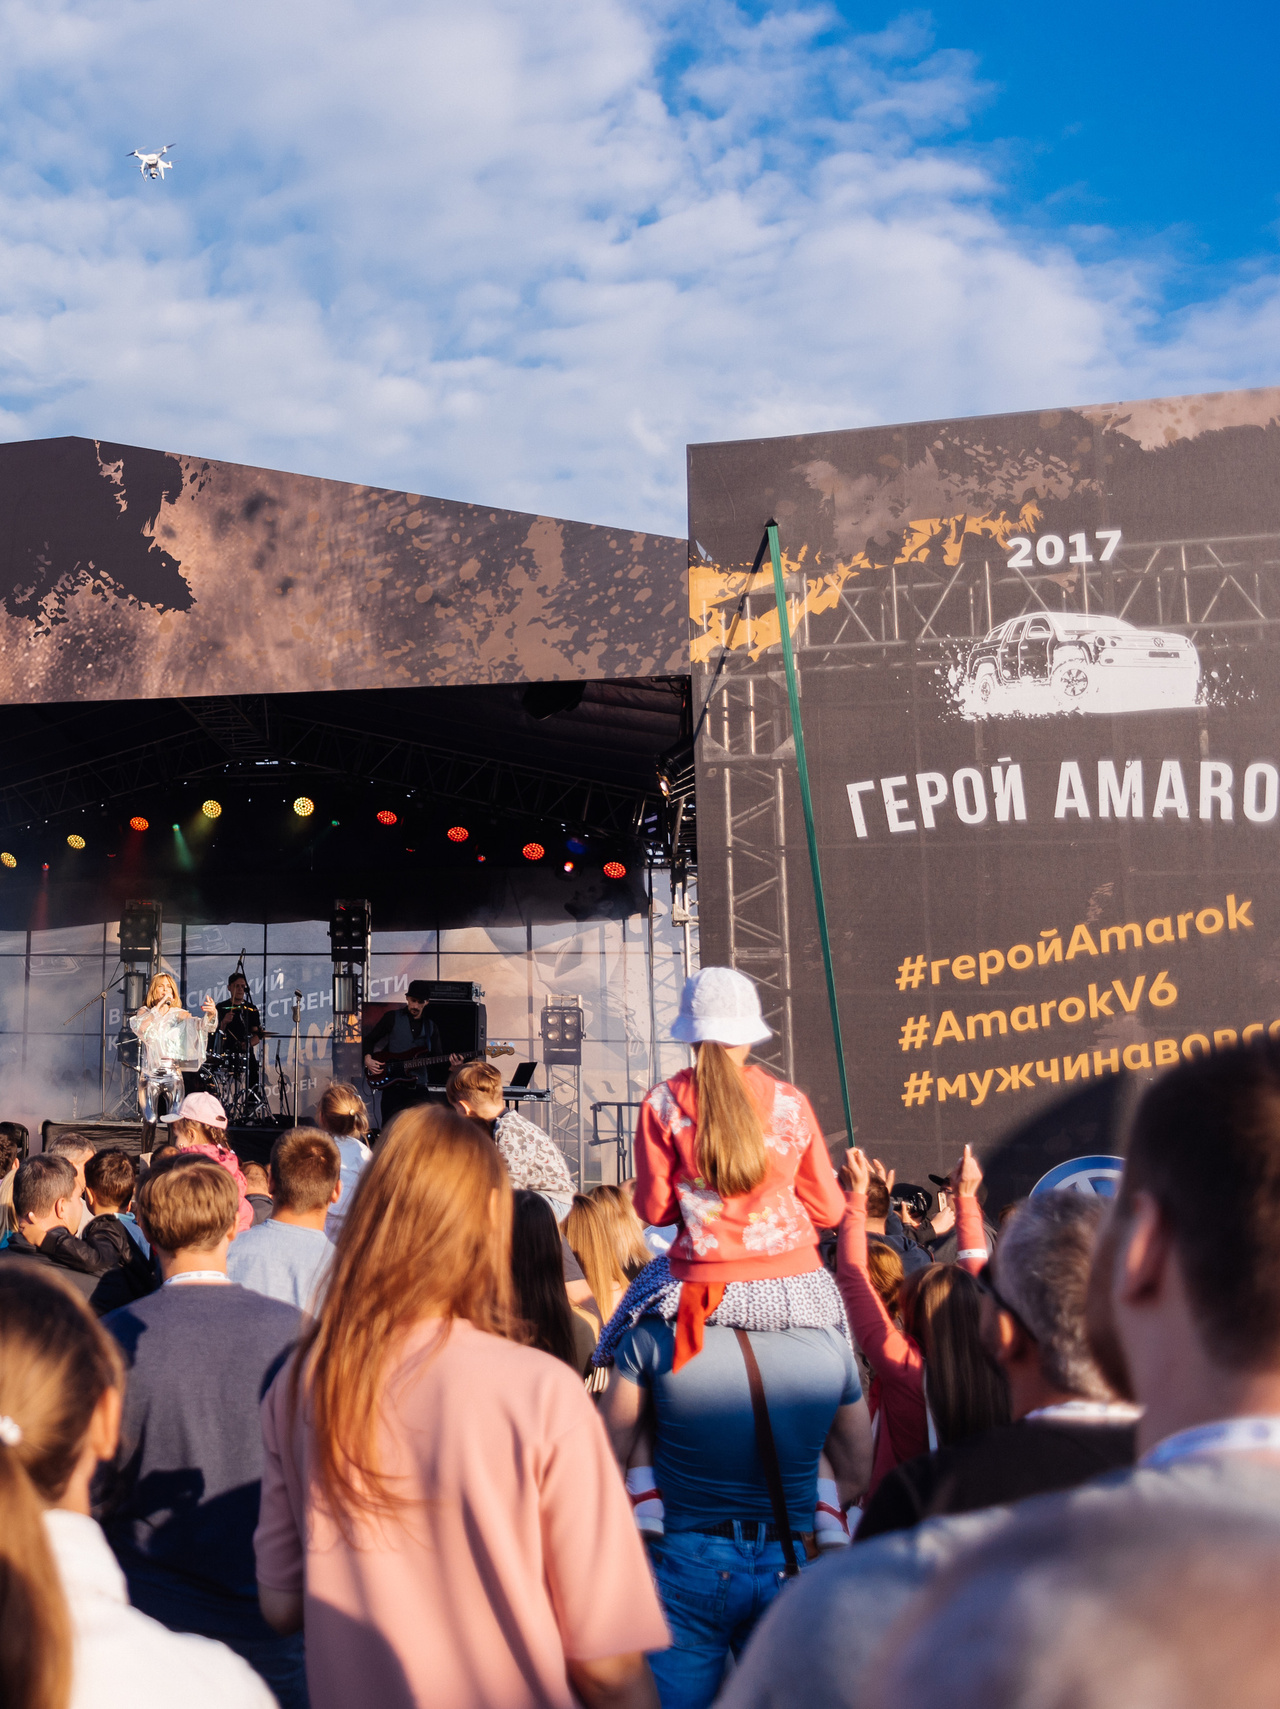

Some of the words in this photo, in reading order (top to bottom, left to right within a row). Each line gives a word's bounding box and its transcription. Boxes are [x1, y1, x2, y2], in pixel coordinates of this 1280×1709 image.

[1006, 529, 1122, 568] 2017
[846, 756, 1028, 838] ГЕРОЙ
[895, 893, 1255, 991] #геройAmarok
[898, 970, 1178, 1052] #AmarokV6
